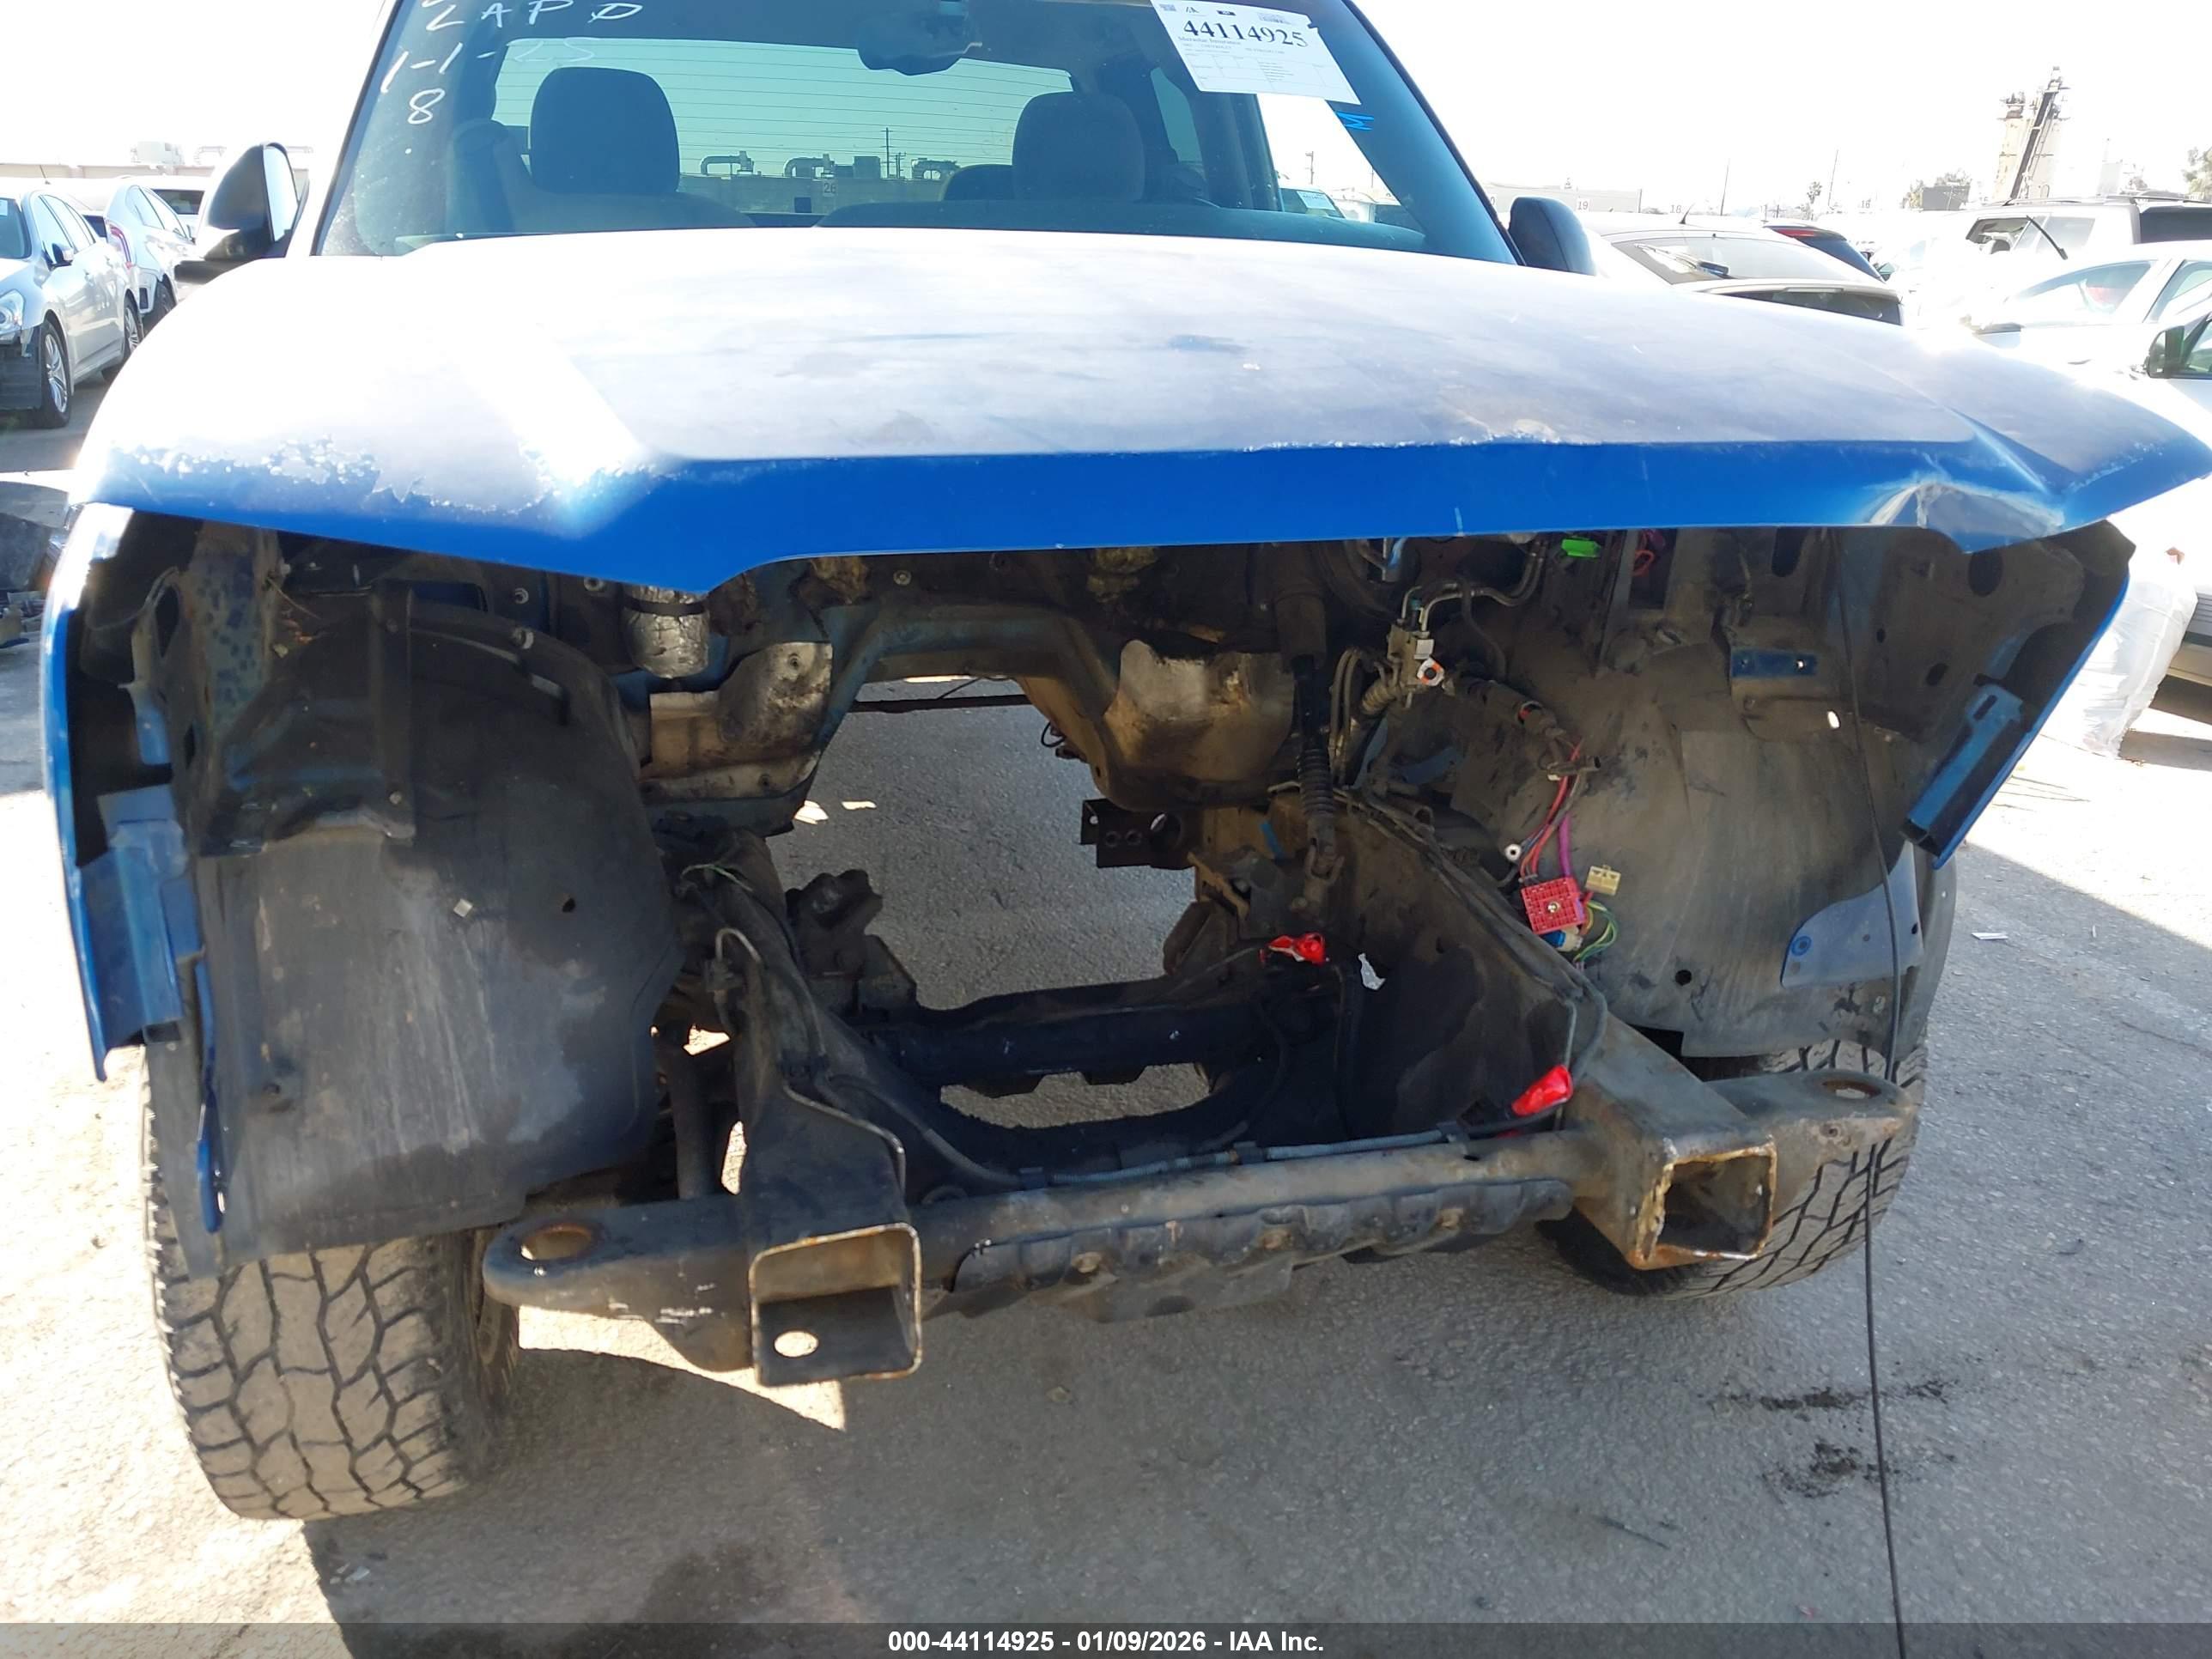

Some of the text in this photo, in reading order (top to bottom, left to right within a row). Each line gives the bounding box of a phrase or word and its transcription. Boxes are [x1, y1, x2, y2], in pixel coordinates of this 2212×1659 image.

[1182, 20, 1309, 47] 44114925
[407, 88, 446, 125] 8
[1577, 201, 1589, 210] 19
